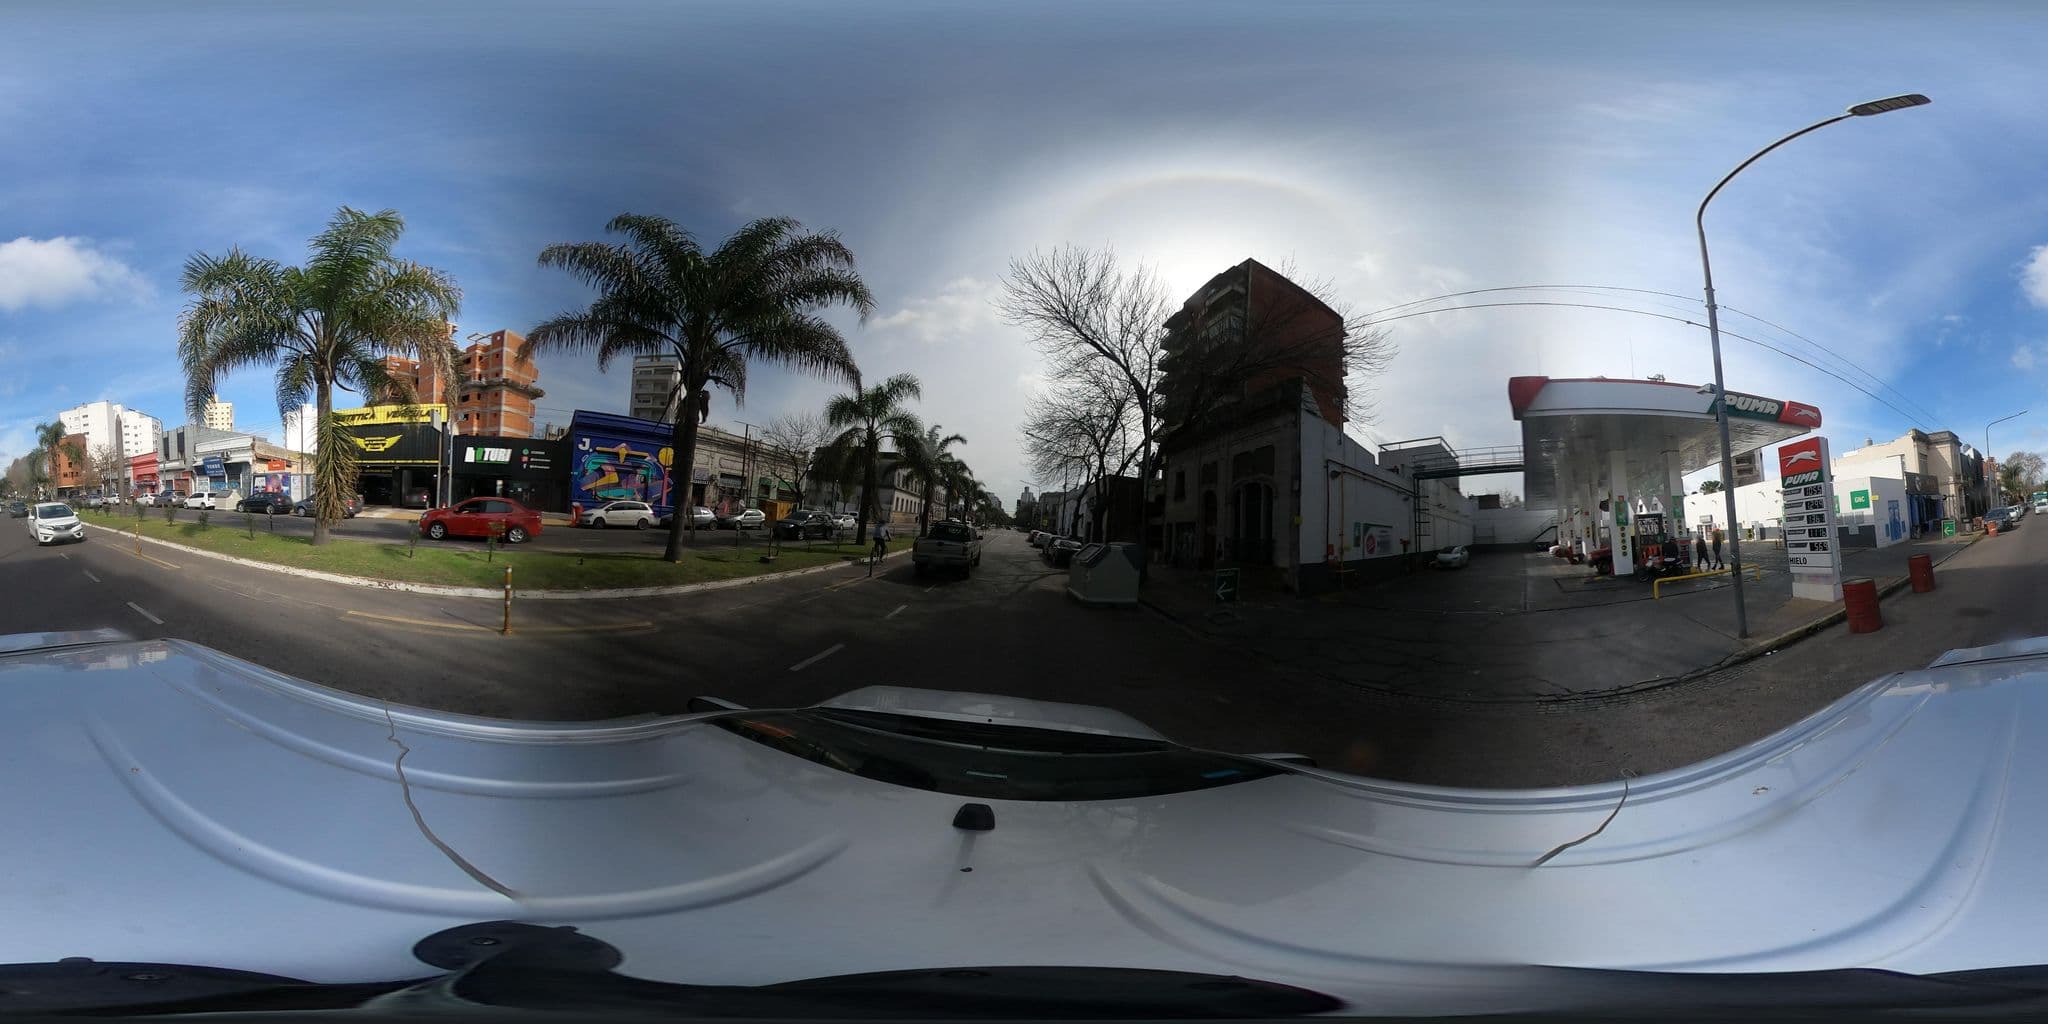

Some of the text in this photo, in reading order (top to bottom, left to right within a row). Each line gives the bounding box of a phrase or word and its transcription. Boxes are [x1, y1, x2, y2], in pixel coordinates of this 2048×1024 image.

[1725, 394, 1778, 415] PUMA
[1784, 471, 1819, 486] PUMA
[1790, 557, 1808, 565] HIELO
